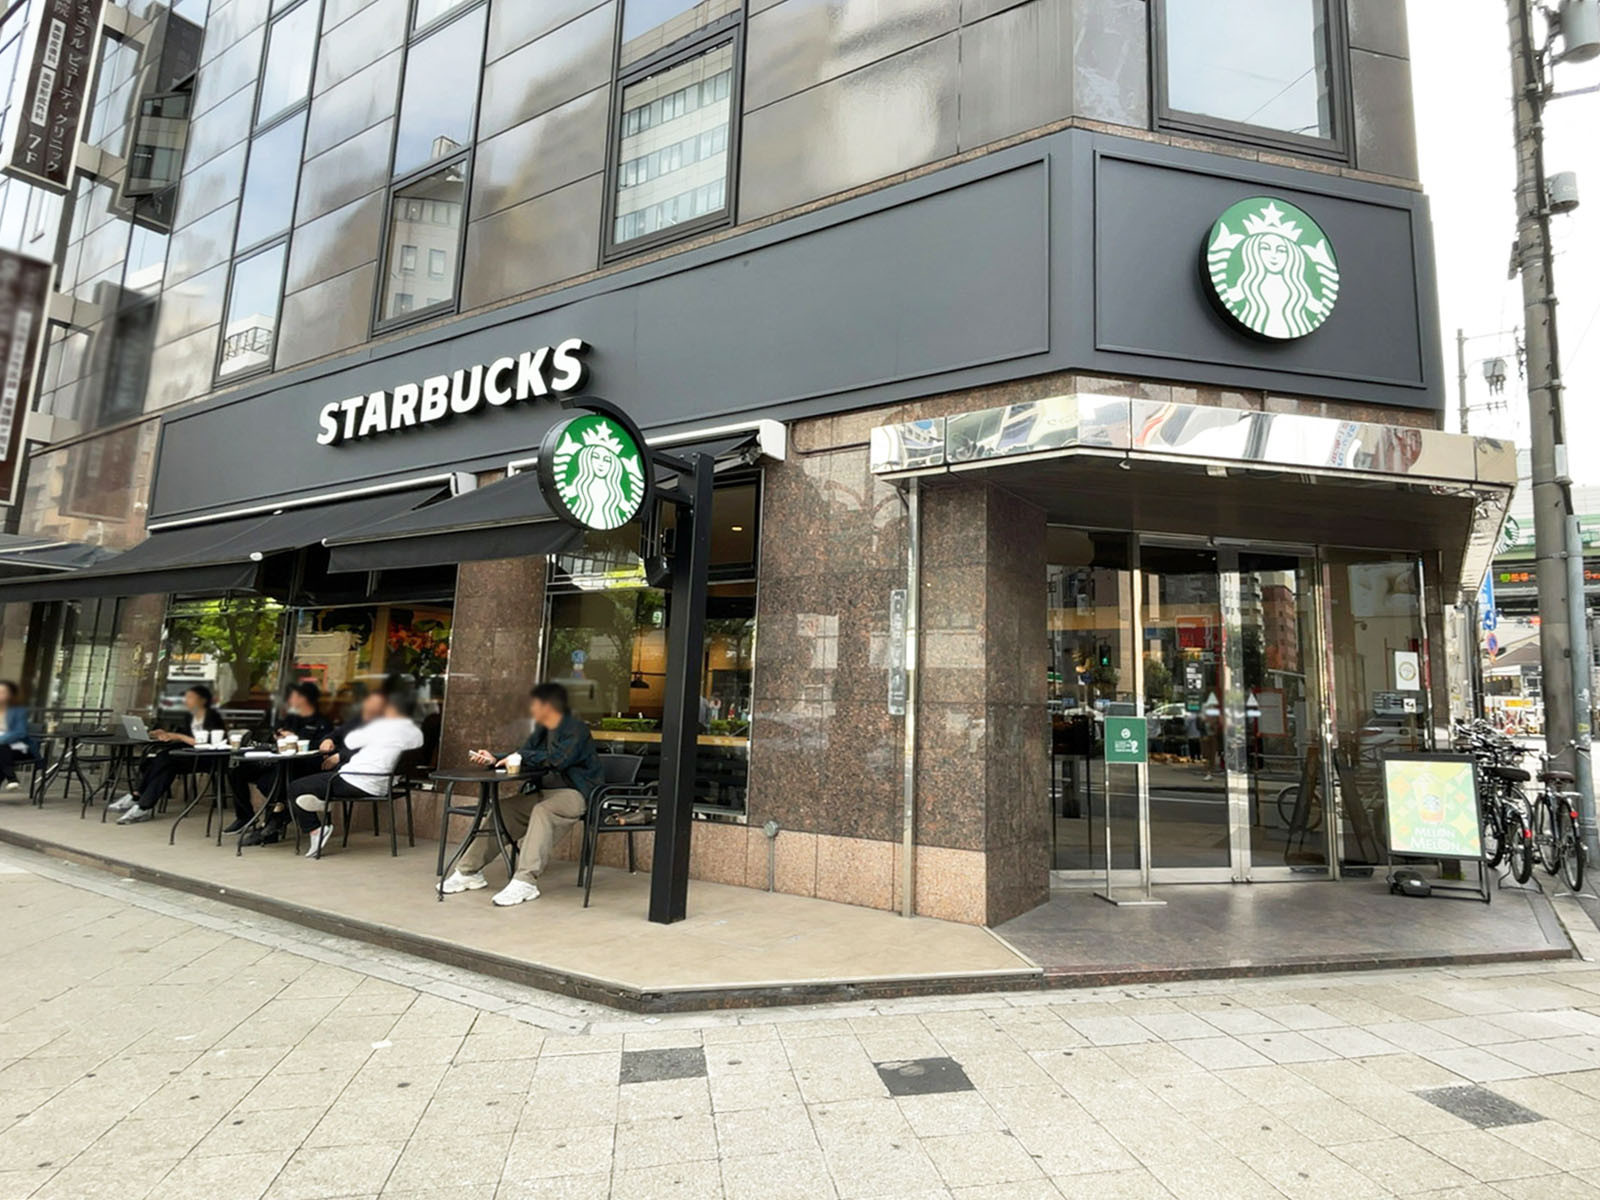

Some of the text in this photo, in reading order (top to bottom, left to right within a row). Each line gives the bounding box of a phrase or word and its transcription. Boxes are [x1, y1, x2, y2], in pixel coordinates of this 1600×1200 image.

[69, 0, 91, 49] チュラル
[47, 113, 68, 172] クリニック
[316, 338, 583, 445] STARBUCKS
